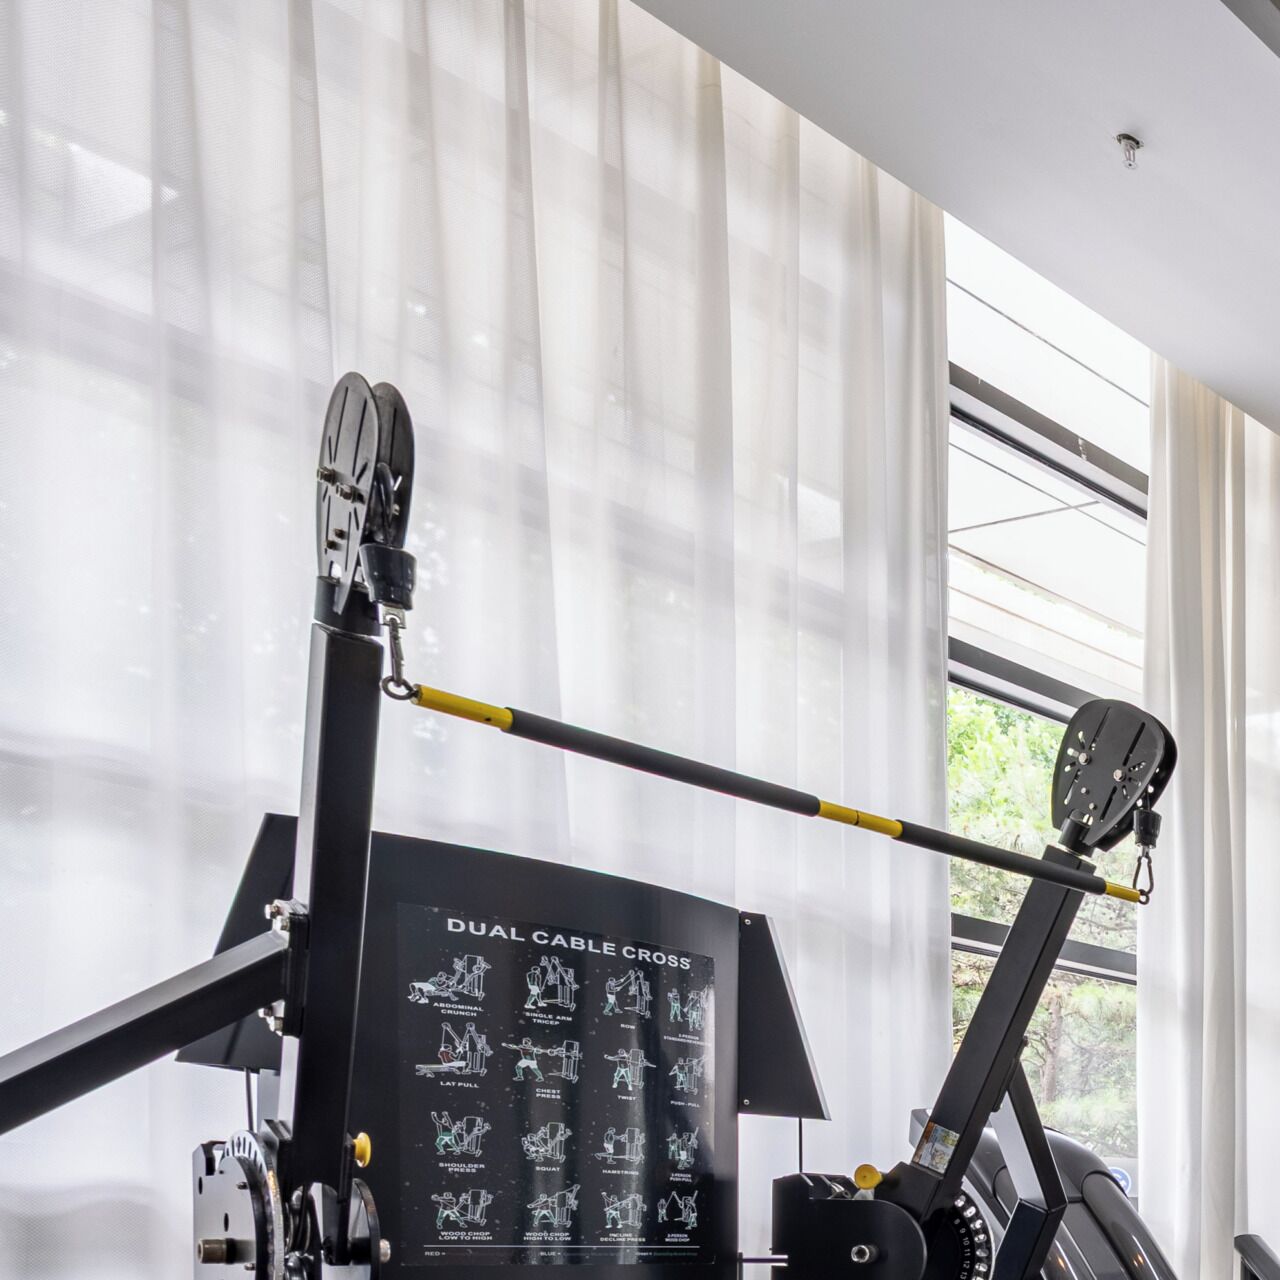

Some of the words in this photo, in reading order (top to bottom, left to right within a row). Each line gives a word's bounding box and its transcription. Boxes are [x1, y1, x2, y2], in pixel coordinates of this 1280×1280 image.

[447, 918, 526, 942] DUAL
[532, 930, 617, 957] CABLE
[622, 945, 691, 971] CROSS
[432, 1002, 485, 1013] ABDOMINAL
[440, 1008, 477, 1017] CRUNCH
[525, 1012, 553, 1021] SINGLE
[532, 1018, 560, 1026] TRICEP
[962, 1237, 970, 1246] 10
[963, 1261, 970, 1269] 12
[960, 1271, 968, 1280] 13
